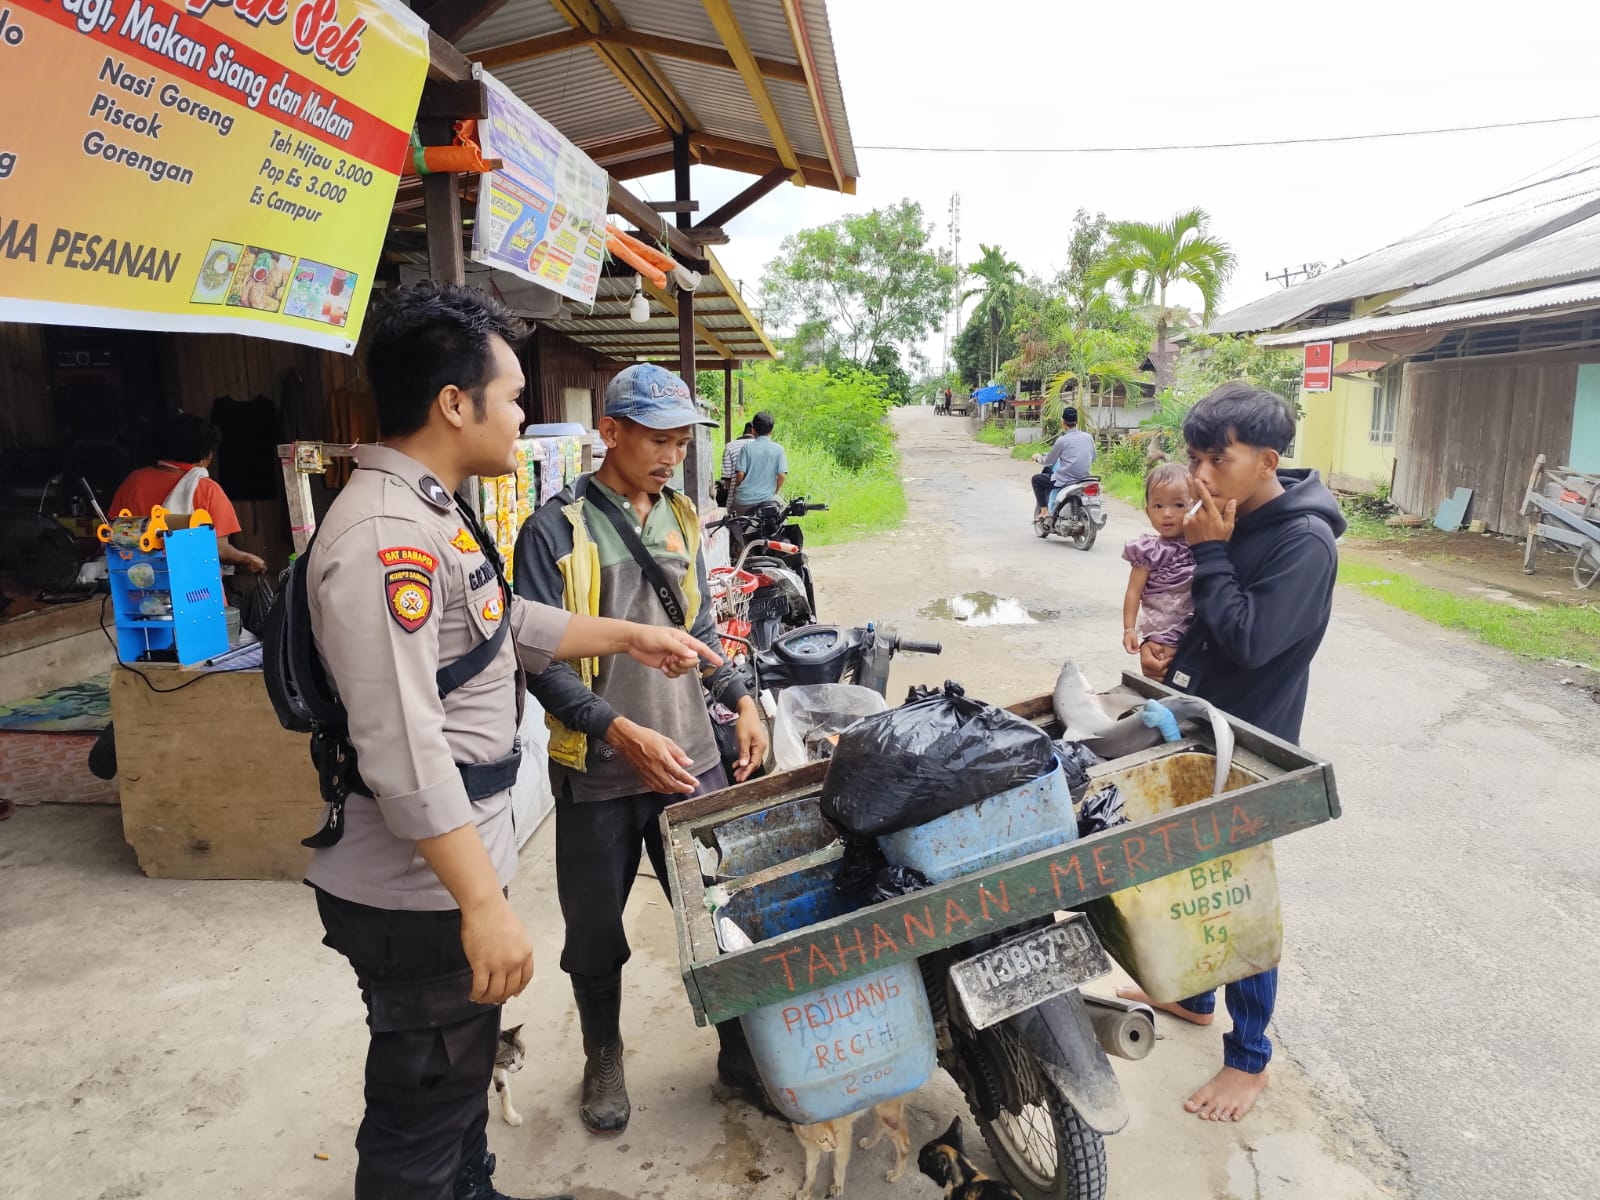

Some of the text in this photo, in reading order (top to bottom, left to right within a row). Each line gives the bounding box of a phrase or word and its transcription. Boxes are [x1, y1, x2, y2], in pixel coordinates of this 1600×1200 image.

[60, 0, 116, 34] agi,
[119, 0, 207, 72] Makan
[208, 42, 268, 108] Siang
[268, 72, 302, 116] dan
[299, 90, 354, 141] Malam
[98, 56, 235, 136] Nasi Goreng
[89, 93, 162, 139] Piscok
[82, 131, 194, 185] Gorengan
[259, 158, 347, 203] Pop Es 3.000
[270, 129, 373, 186] Teh Hijau 3.000
[249, 185, 322, 222] Es Campur
[47, 228, 181, 283] PESANAN
[761, 805, 1260, 991] TAHANAN MERTUA
[1190, 860, 1232, 890] BER
[782, 976, 900, 1036] PEJUANG
